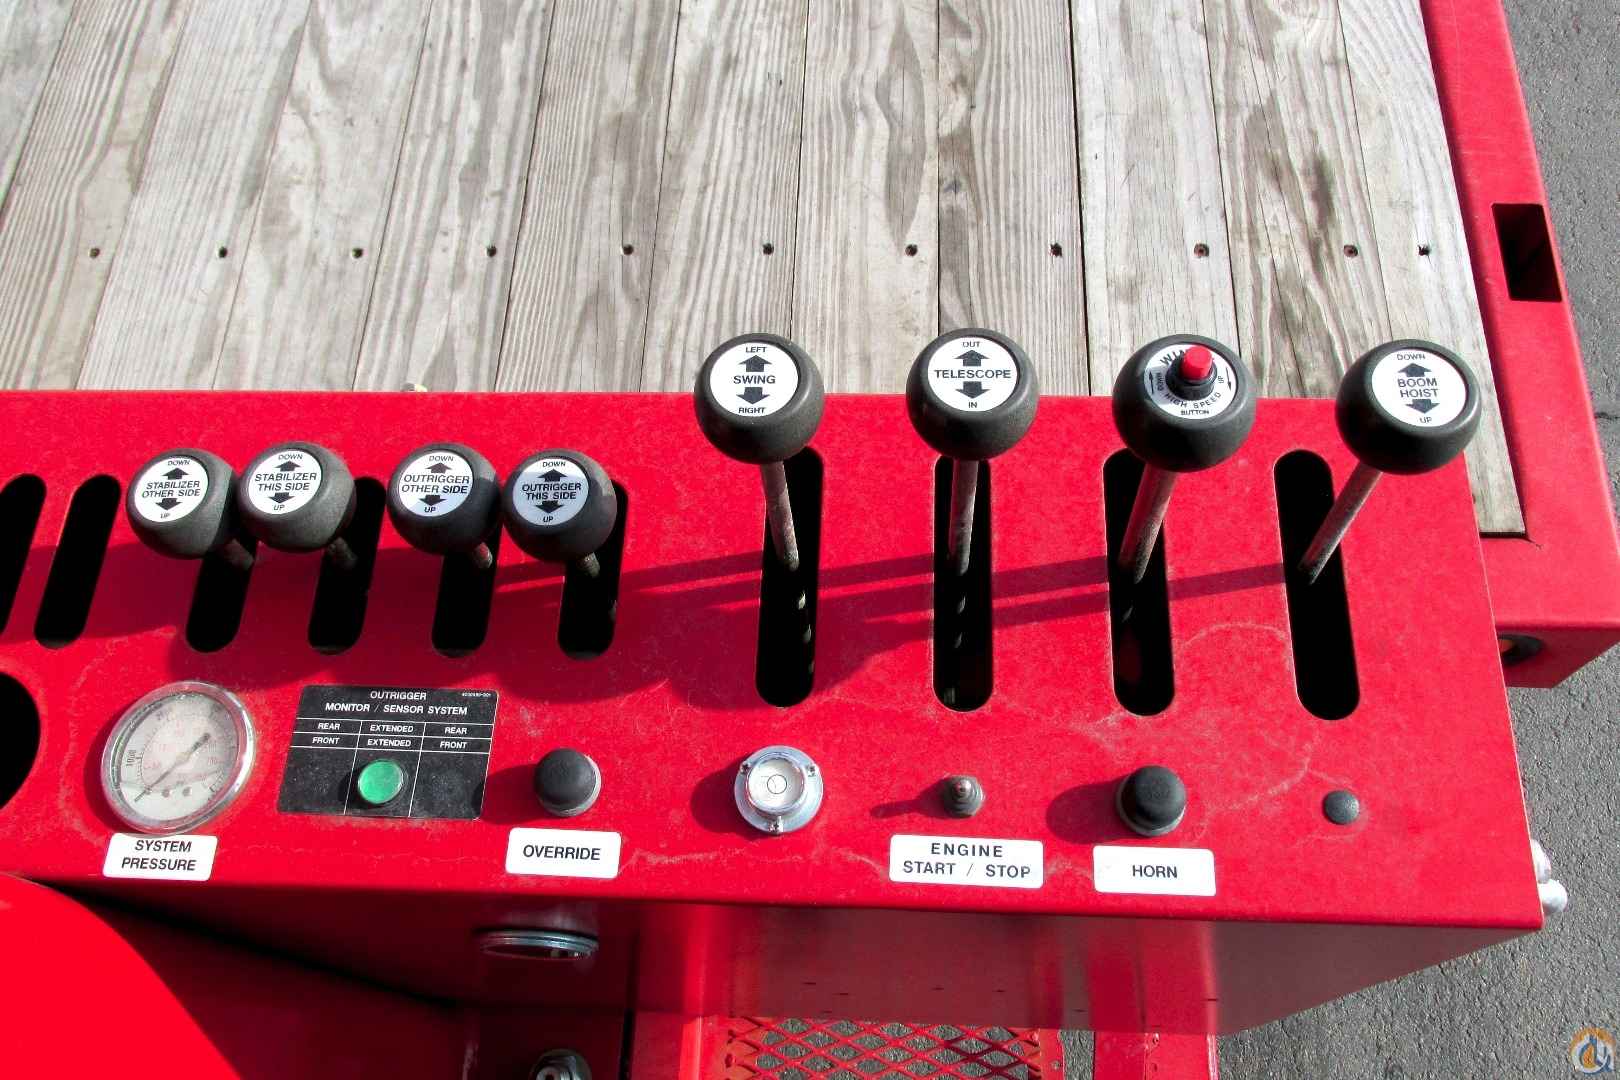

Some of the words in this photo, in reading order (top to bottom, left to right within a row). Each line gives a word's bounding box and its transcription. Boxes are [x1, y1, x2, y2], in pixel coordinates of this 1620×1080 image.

[933, 369, 1012, 379] TELESCOPE
[733, 375, 776, 385] SWING
[1218, 375, 1225, 384] UP
[1397, 377, 1438, 388] BOOM
[1400, 388, 1439, 398] HOIST
[1164, 393, 1188, 408] HIGH
[1193, 391, 1222, 409] SPEED
[1419, 416, 1433, 424] UP
[254, 472, 317, 482] STABILIZER
[403, 474, 470, 484] OUTRIGGER
[146, 480, 201, 490] STABILIZER
[257, 482, 283, 491] THIS
[284, 482, 310, 491] SIDE
[401, 484, 440, 494] OTHER
[442, 485, 468, 494] SIDE
[521, 482, 582, 492] OUTRIGGER
[142, 489, 174, 498] OTHER
[177, 488, 201, 497] SIDE
[526, 492, 549, 500] THIS
[552, 491, 577, 500] SIDE
[542, 515, 554, 523] UP
[370, 690, 427, 701] OUTRIGGER
[325, 702, 370, 712] MONITOR
[383, 705, 424, 714] SENSOR
[427, 706, 468, 716] SYSTEM
[317, 722, 340, 730] REAR
[369, 724, 414, 733] EXTENDED
[444, 726, 468, 735] REAR
[312, 736, 340, 745] FRONT
[367, 738, 412, 747] EXTENDED
[439, 741, 468, 749] FRONT
[134, 839, 193, 853] SYSTEM
[930, 842, 1003, 858] ENGINE
[522, 844, 601, 861] OVERRIDE
[121, 857, 198, 871] PRESSURE
[902, 860, 957, 876] START
[985, 864, 1031, 879] STOP
[1131, 864, 1179, 880] HORN
